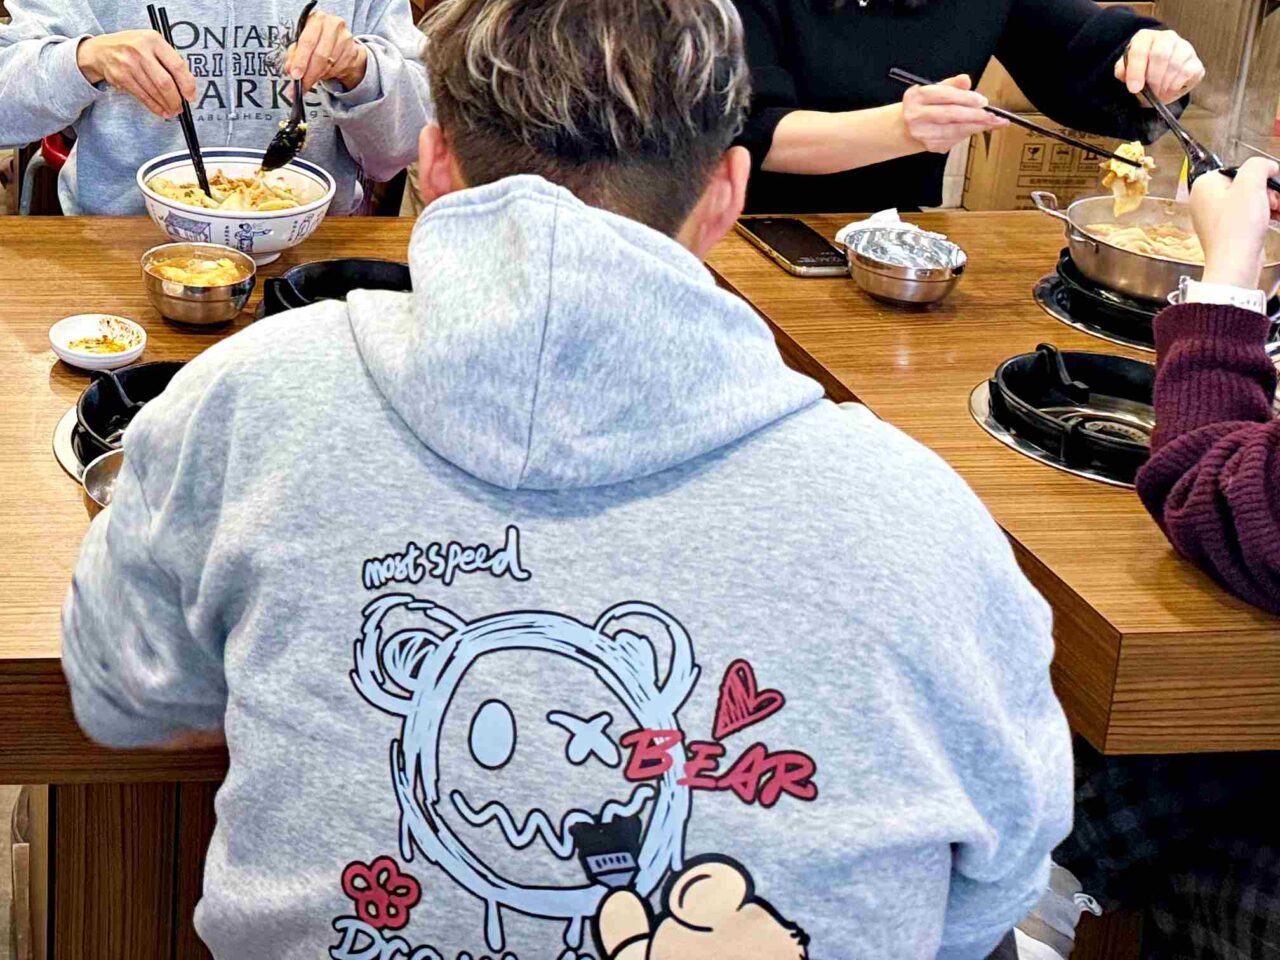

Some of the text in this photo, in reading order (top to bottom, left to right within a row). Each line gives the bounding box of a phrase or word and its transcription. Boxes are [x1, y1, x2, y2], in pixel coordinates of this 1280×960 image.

[195, 79, 321, 109] ARK
[363, 525, 531, 589] most speed
[621, 727, 818, 807] BEAR
